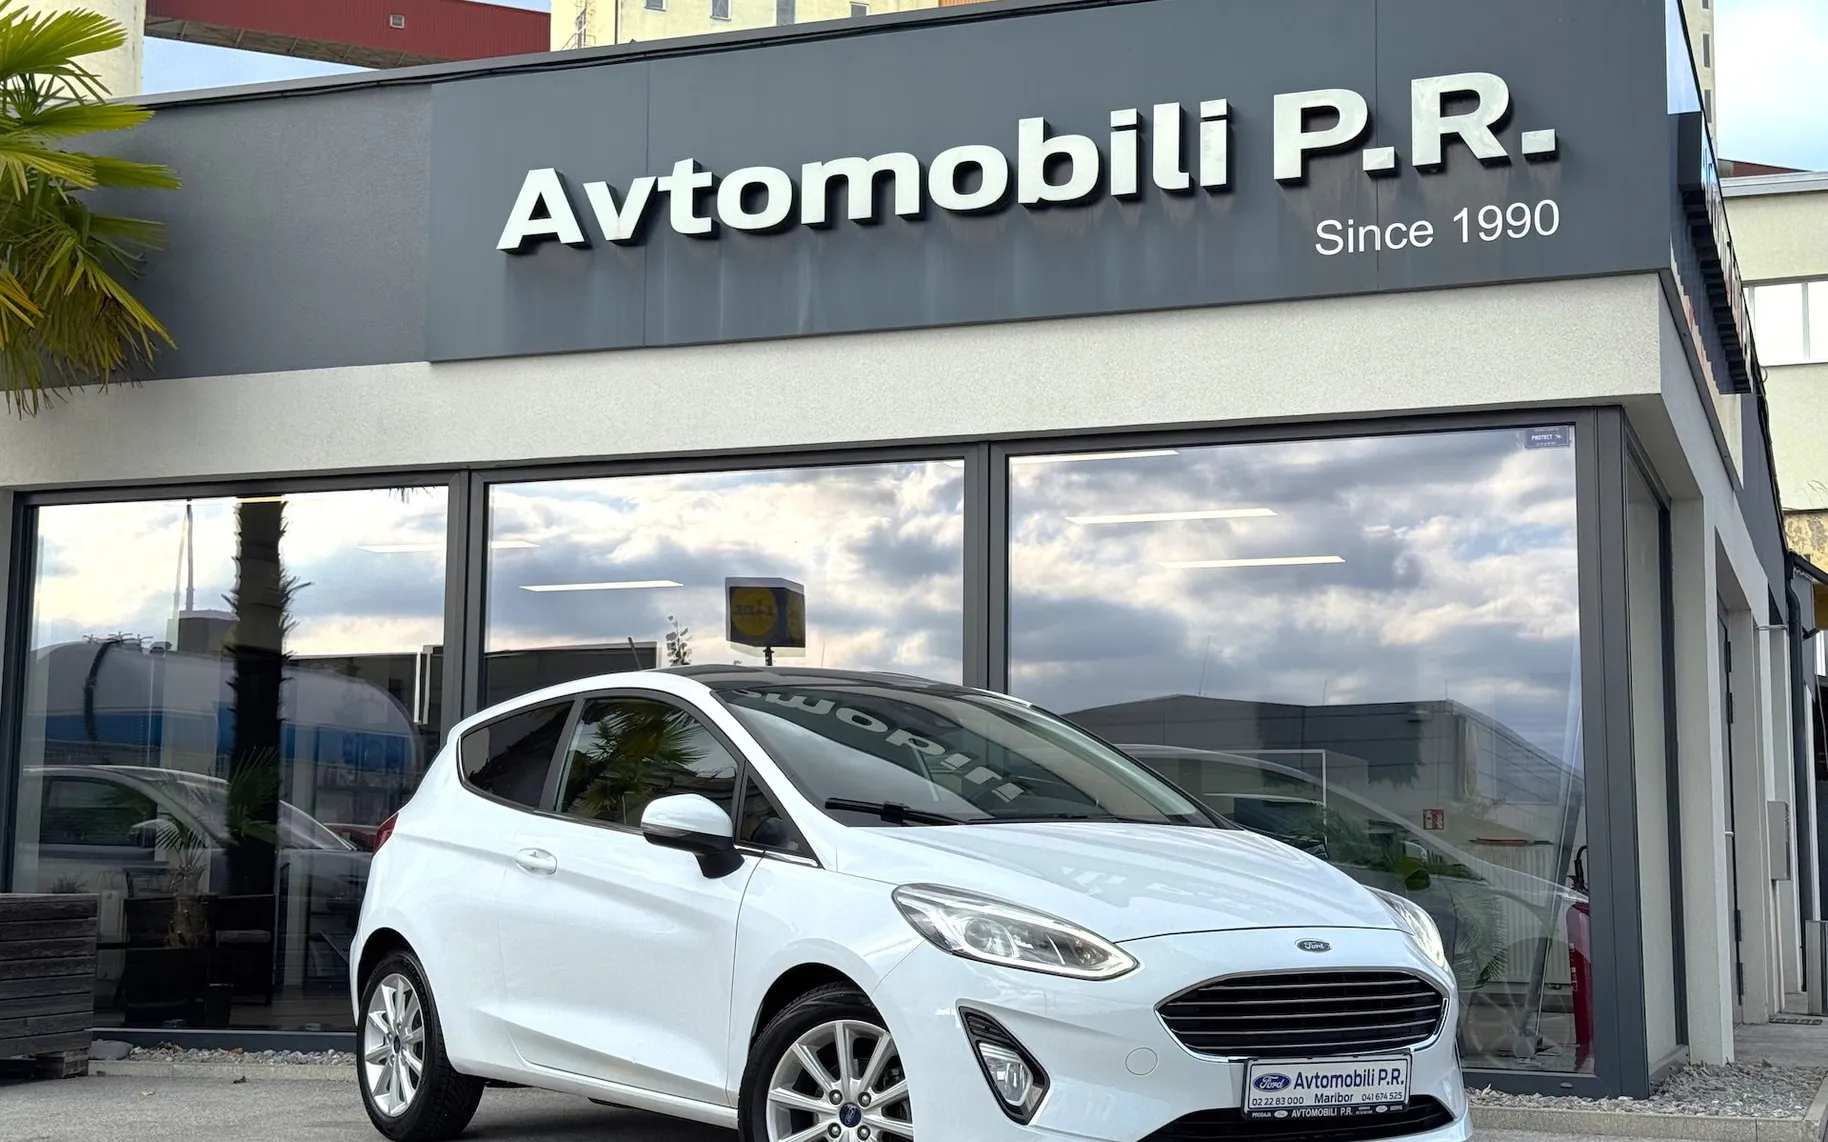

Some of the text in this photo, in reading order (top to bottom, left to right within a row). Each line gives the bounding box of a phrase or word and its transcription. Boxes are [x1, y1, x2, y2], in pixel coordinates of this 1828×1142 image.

[496, 72, 1556, 251] Avtomobili P.R.
[1315, 199, 1560, 256] Since 1990
[1258, 1068, 1404, 1090] Ford Avtomobili P.R.
[1252, 1091, 1403, 1106] 02 22 83 000 Maribor 041 674 525
[1291, 1107, 1337, 1118] AVTOMOBILI
[1340, 1107, 1353, 1116] P.R.
